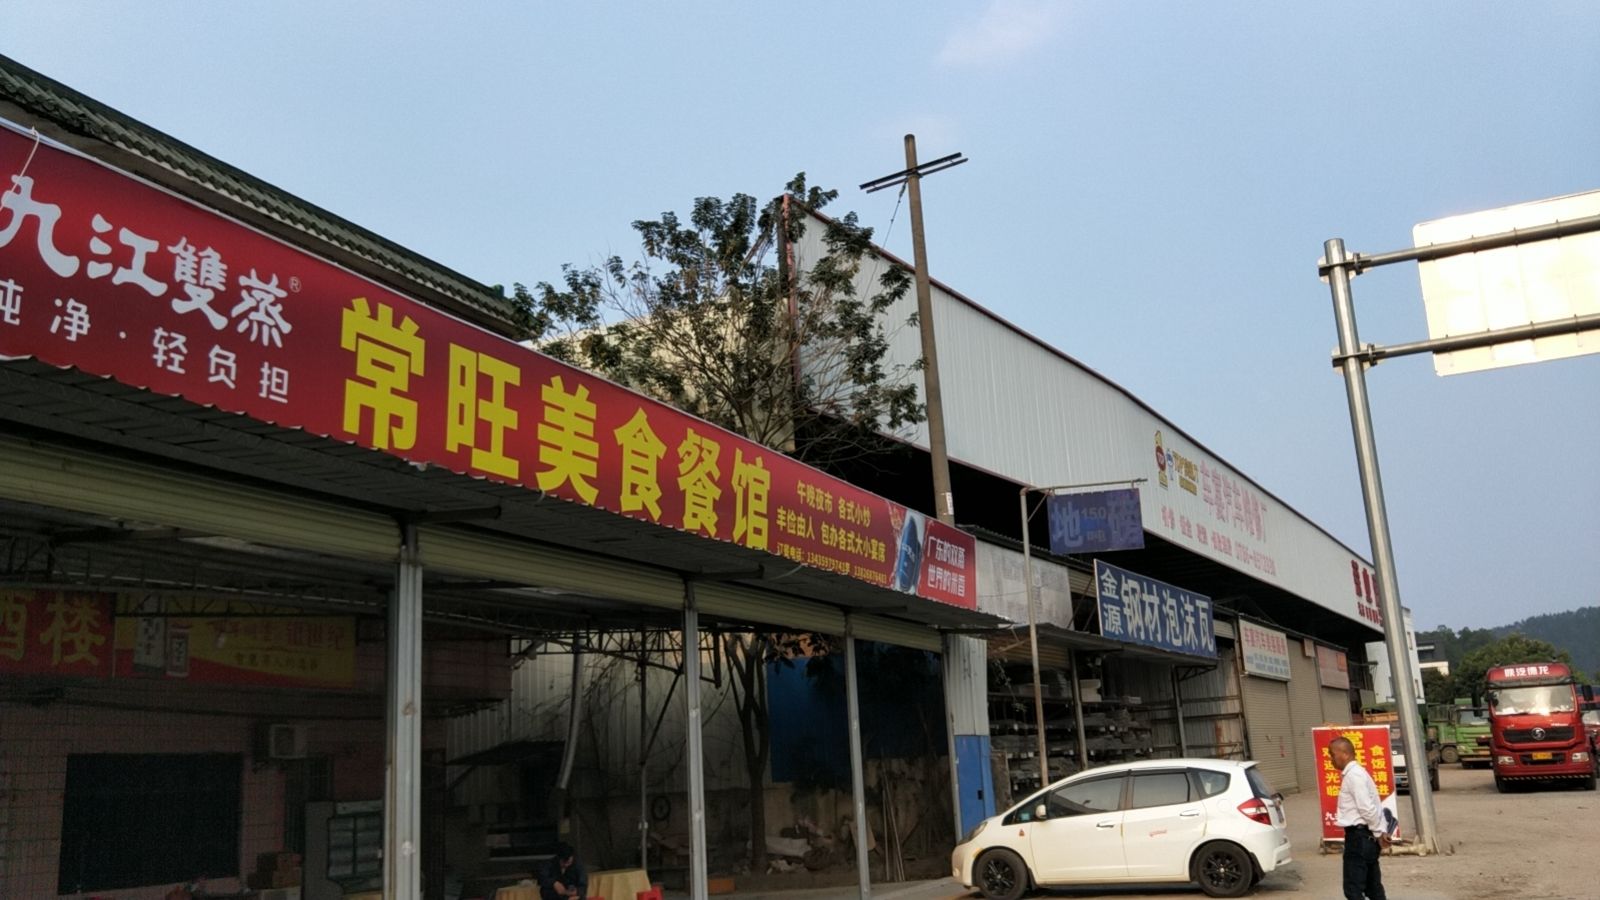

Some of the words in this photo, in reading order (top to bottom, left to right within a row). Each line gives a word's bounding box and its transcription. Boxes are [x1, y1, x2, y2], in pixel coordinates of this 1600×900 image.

[341, 297, 770, 551] 常旺美食餐馆
[776, 506, 815, 540] 丰俭由人
[838, 498, 871, 529] 各式小炒
[1100, 568, 1123, 635] 金源
[1121, 574, 1214, 652] 钢材泡沫瓦
